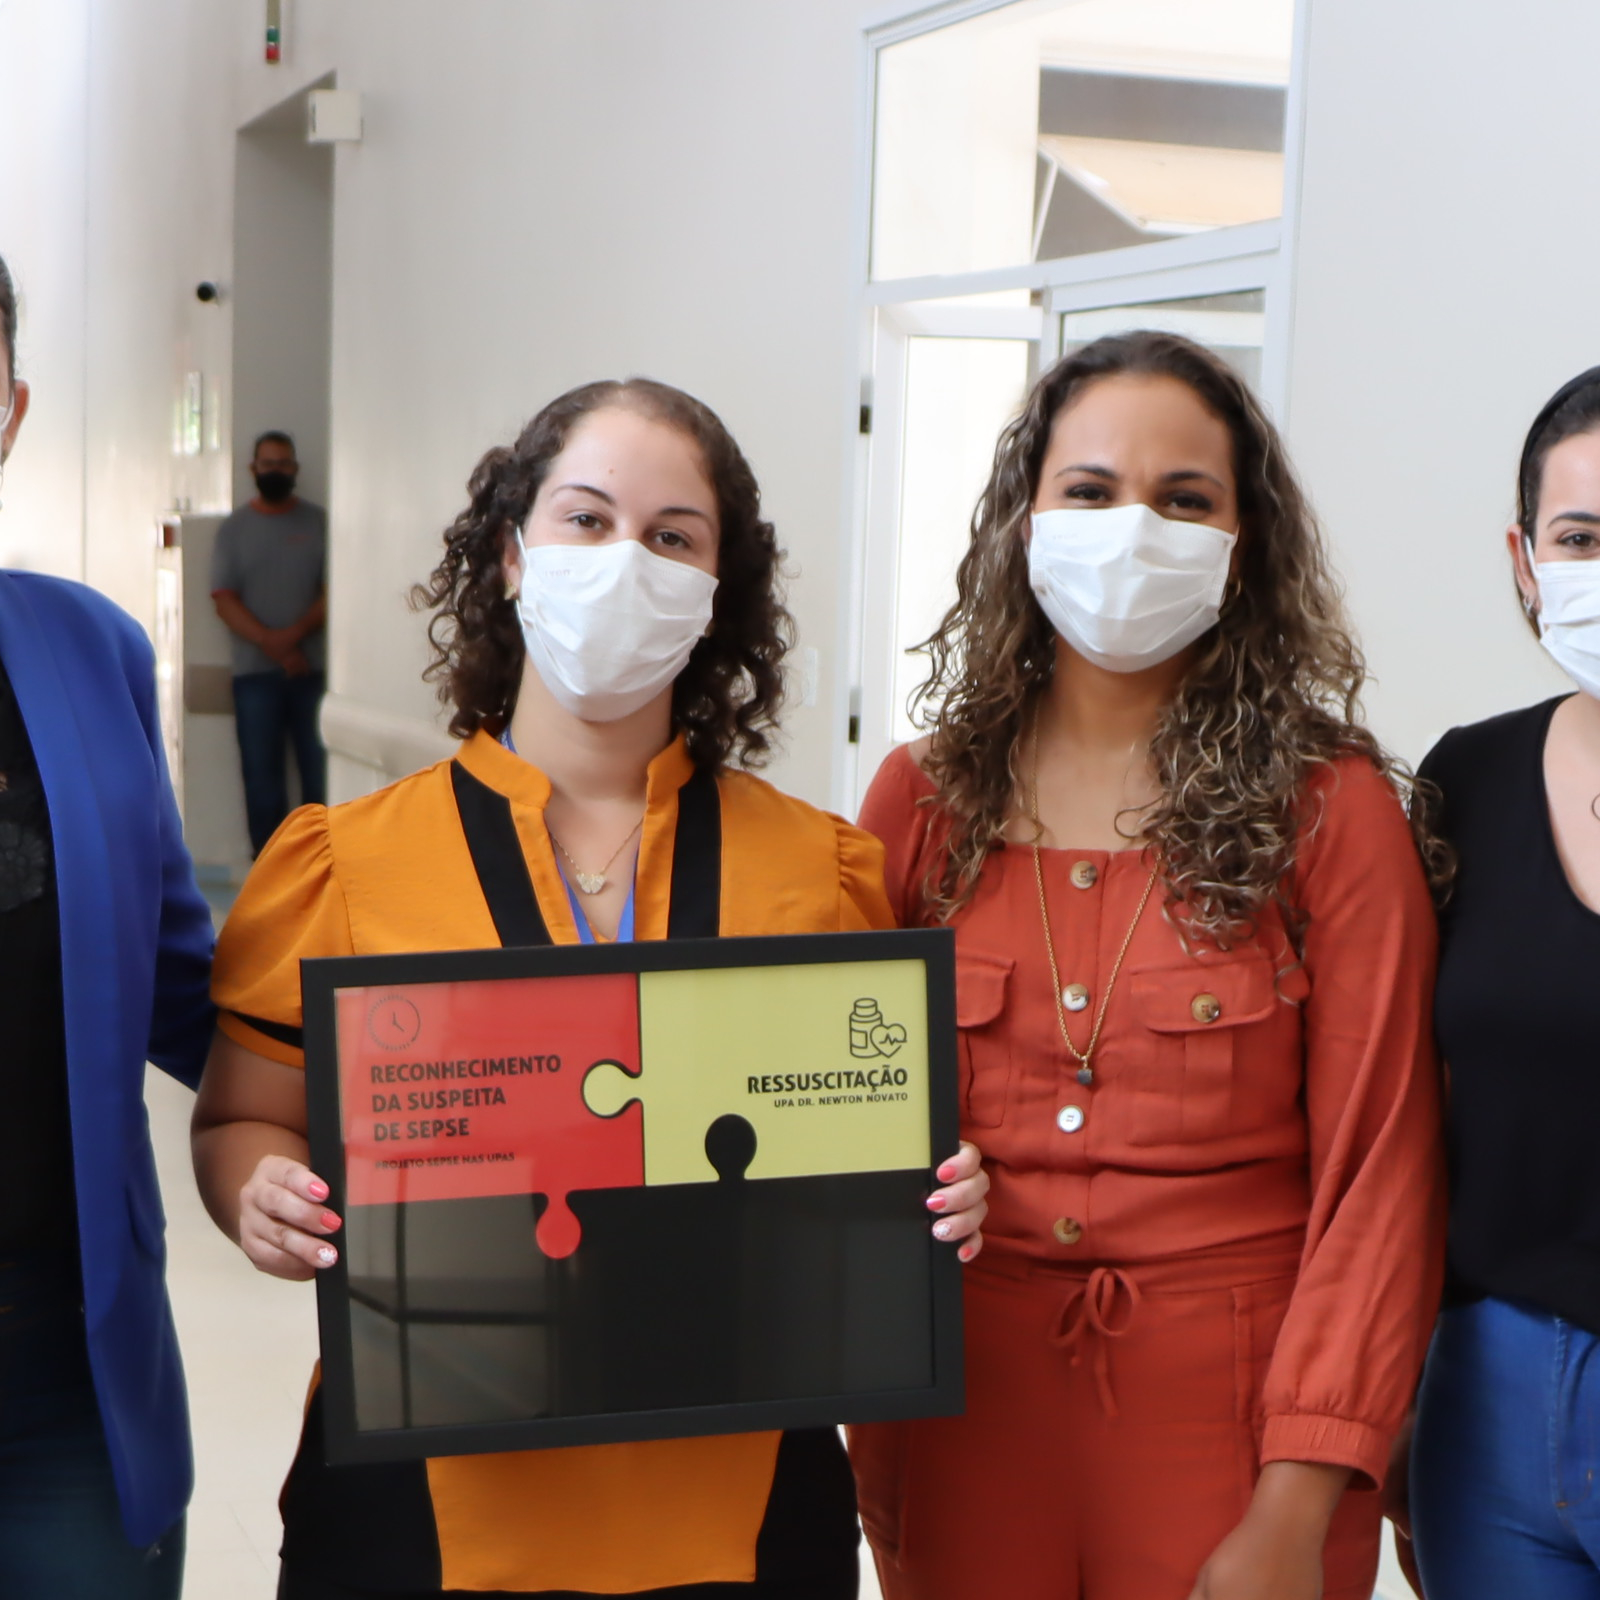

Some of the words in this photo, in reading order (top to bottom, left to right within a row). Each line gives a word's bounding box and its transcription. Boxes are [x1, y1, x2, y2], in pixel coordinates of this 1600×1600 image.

[370, 1054, 561, 1084] RECONHECIMENTO
[747, 1064, 908, 1094] RESSUSCITAÇÃO
[372, 1093, 402, 1113] DA
[407, 1087, 507, 1111] SUSPEITA
[774, 1099, 794, 1108] UPA
[797, 1097, 814, 1107] DR.
[818, 1095, 863, 1106] NEWTON
[866, 1092, 908, 1103] NOVATO
[373, 1122, 401, 1142] DE
[407, 1118, 470, 1140] SEPSE
[374, 1158, 424, 1169] PROJETO
[426, 1155, 459, 1167] SEPSE
[462, 1153, 485, 1164] NAS
[487, 1152, 515, 1162] UPAS
